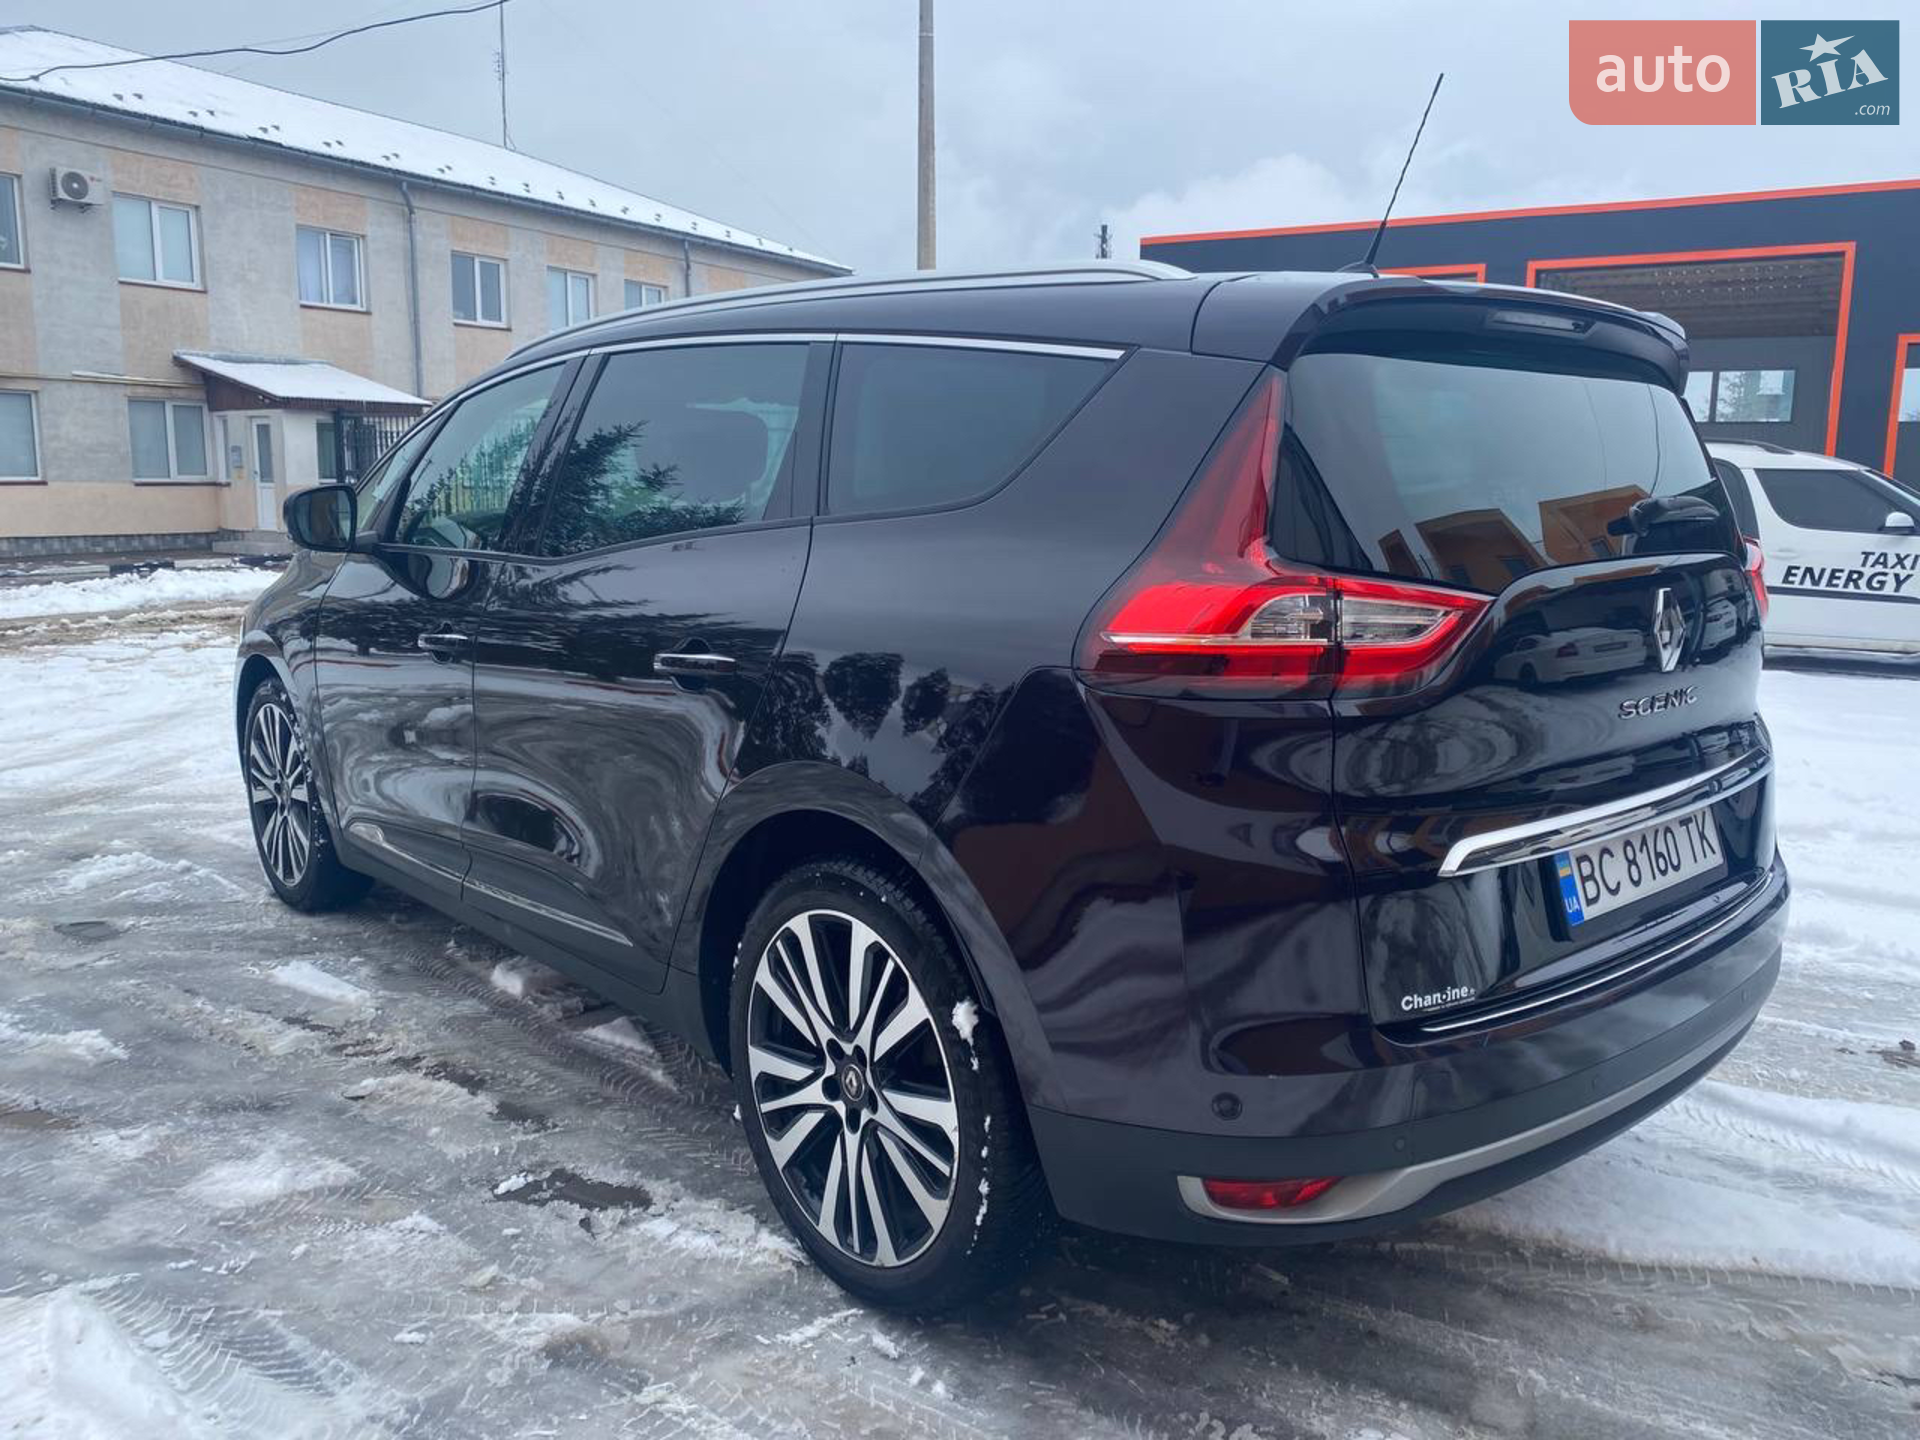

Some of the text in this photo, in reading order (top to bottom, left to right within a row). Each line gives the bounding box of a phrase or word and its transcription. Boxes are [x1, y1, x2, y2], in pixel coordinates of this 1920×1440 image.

[1860, 551, 1920, 571] TAXI
[1781, 565, 1914, 593] ENERGY
[1618, 685, 1699, 719] SCENIC
[1576, 811, 1717, 907] BC 8160 TK
[1564, 896, 1580, 913] UA
